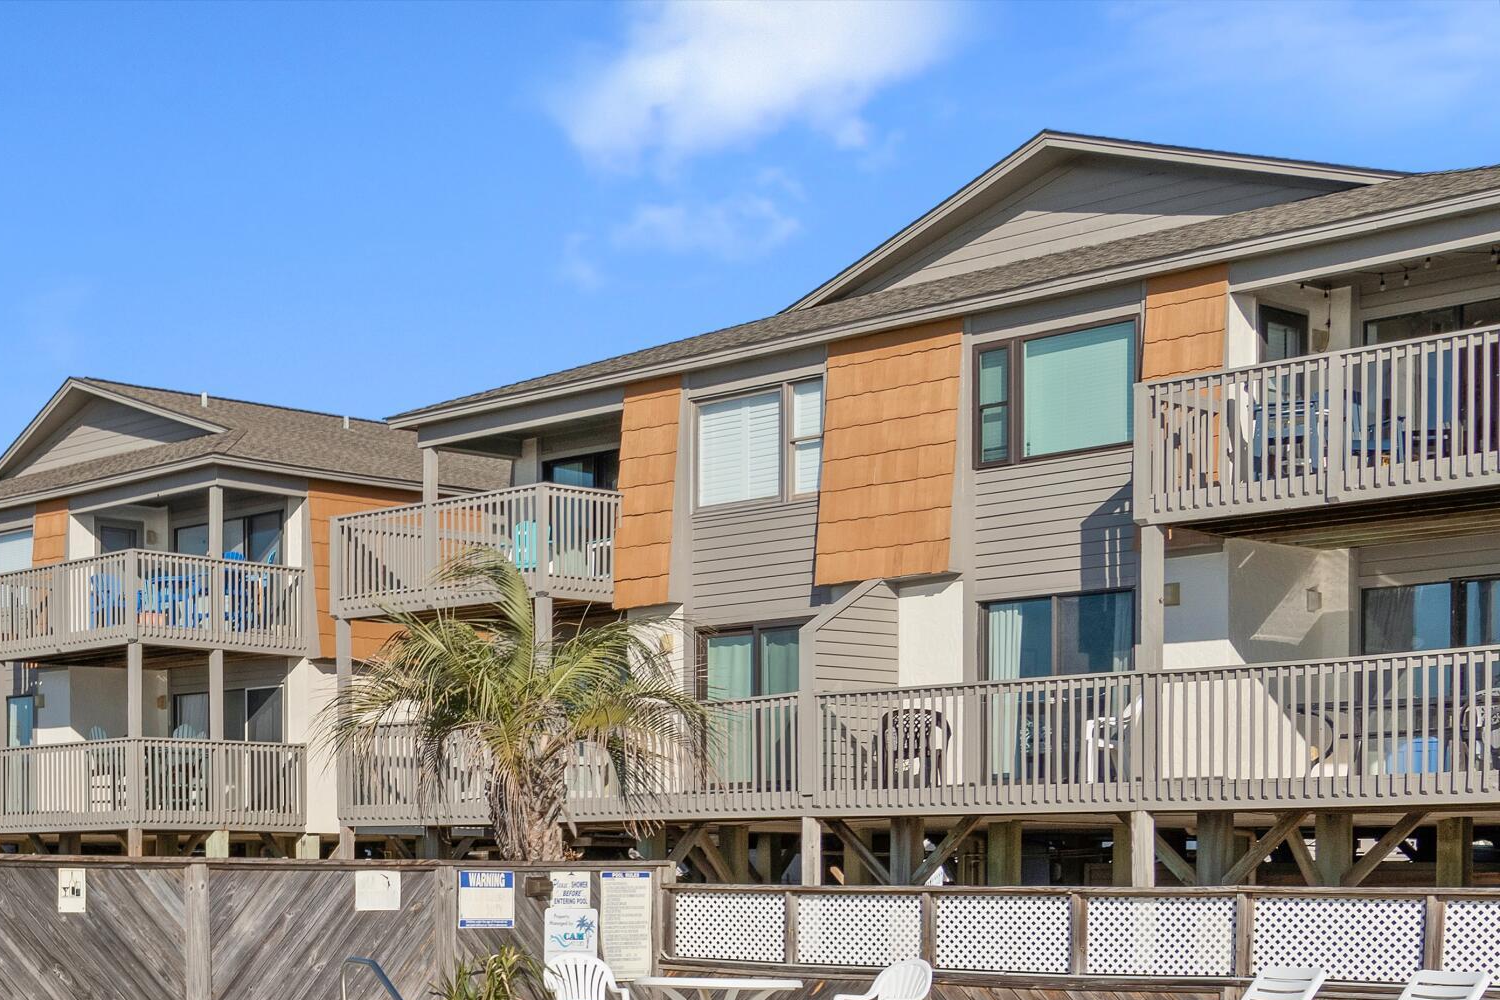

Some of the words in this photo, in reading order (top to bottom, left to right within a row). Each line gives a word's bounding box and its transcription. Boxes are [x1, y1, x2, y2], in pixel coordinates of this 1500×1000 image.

[468, 872, 506, 888] WARNING
[571, 881, 588, 889] SHOWER
[553, 897, 576, 905] ENTERING
[576, 897, 588, 905] POOL
